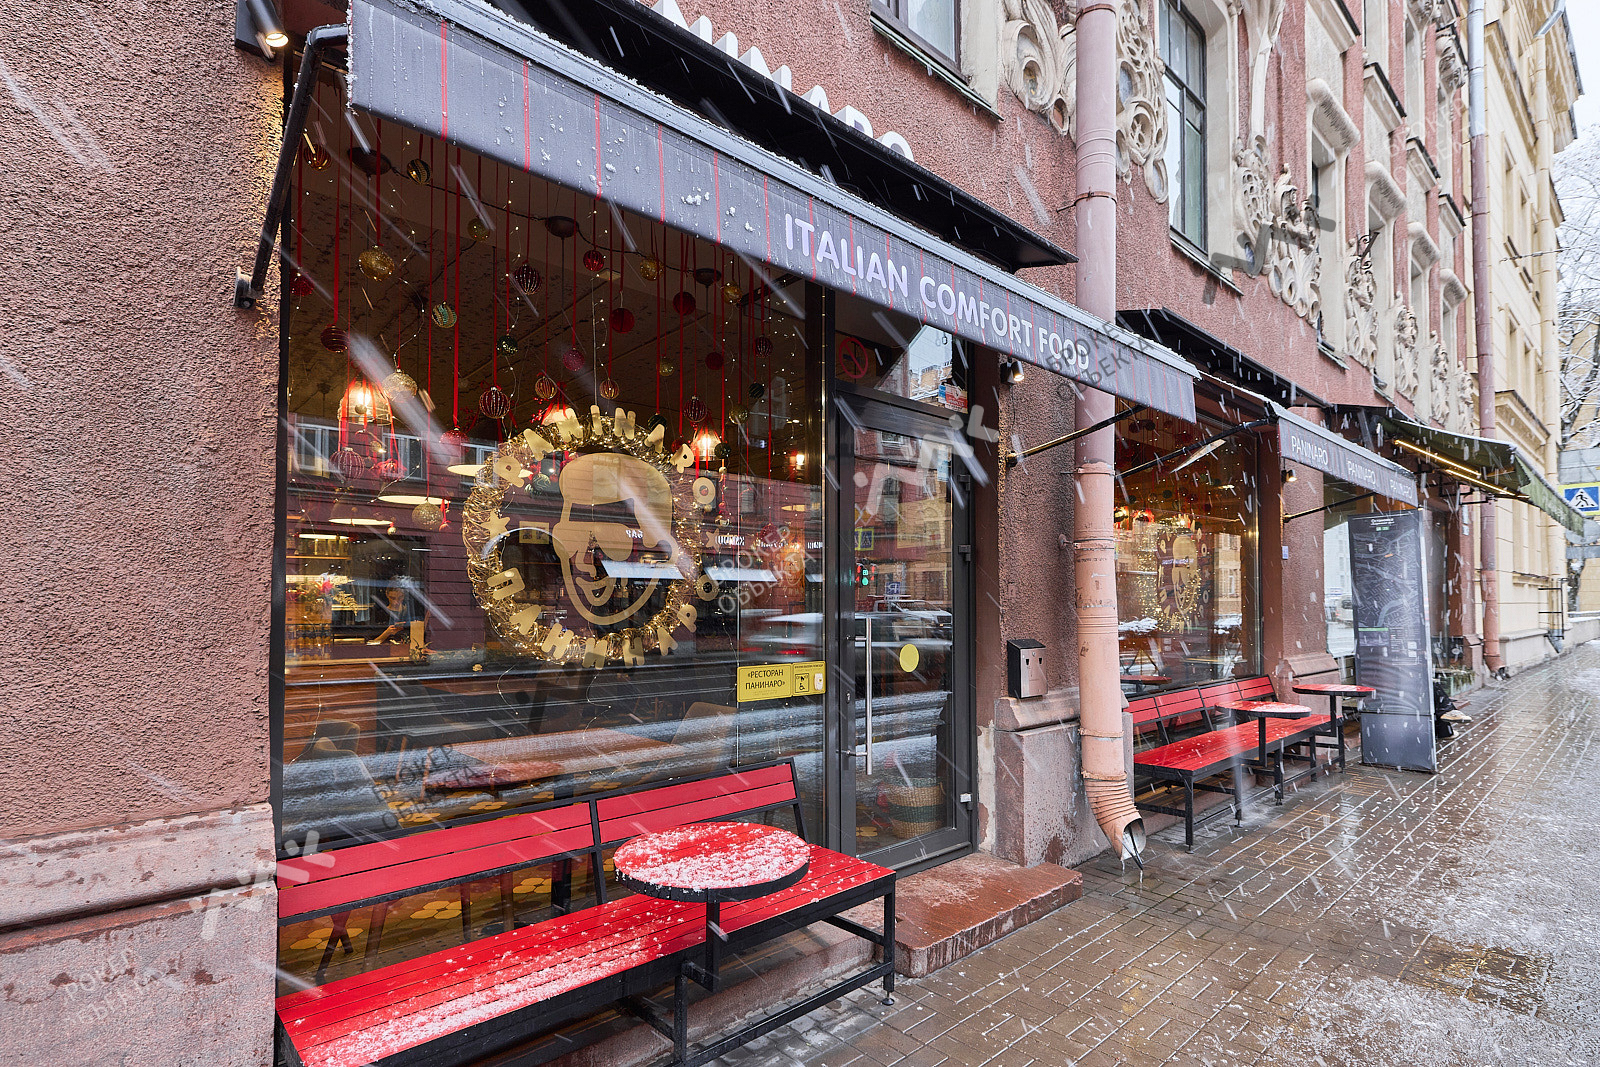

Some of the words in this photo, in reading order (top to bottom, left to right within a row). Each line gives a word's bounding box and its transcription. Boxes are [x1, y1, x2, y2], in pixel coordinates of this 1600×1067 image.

[785, 213, 909, 297] ITALIAN
[919, 276, 1033, 347] COMFORT
[1039, 327, 1089, 370] FOOD
[492, 404, 716, 505] PANINARO
[1291, 435, 1329, 466] PANINARO
[1347, 460, 1376, 485] PANINARO
[487, 567, 719, 671] ПАНИНАРО
[745, 680, 786, 690] ПАНИНАРО»
[748, 669, 784, 678] «РЕСТОРАН
